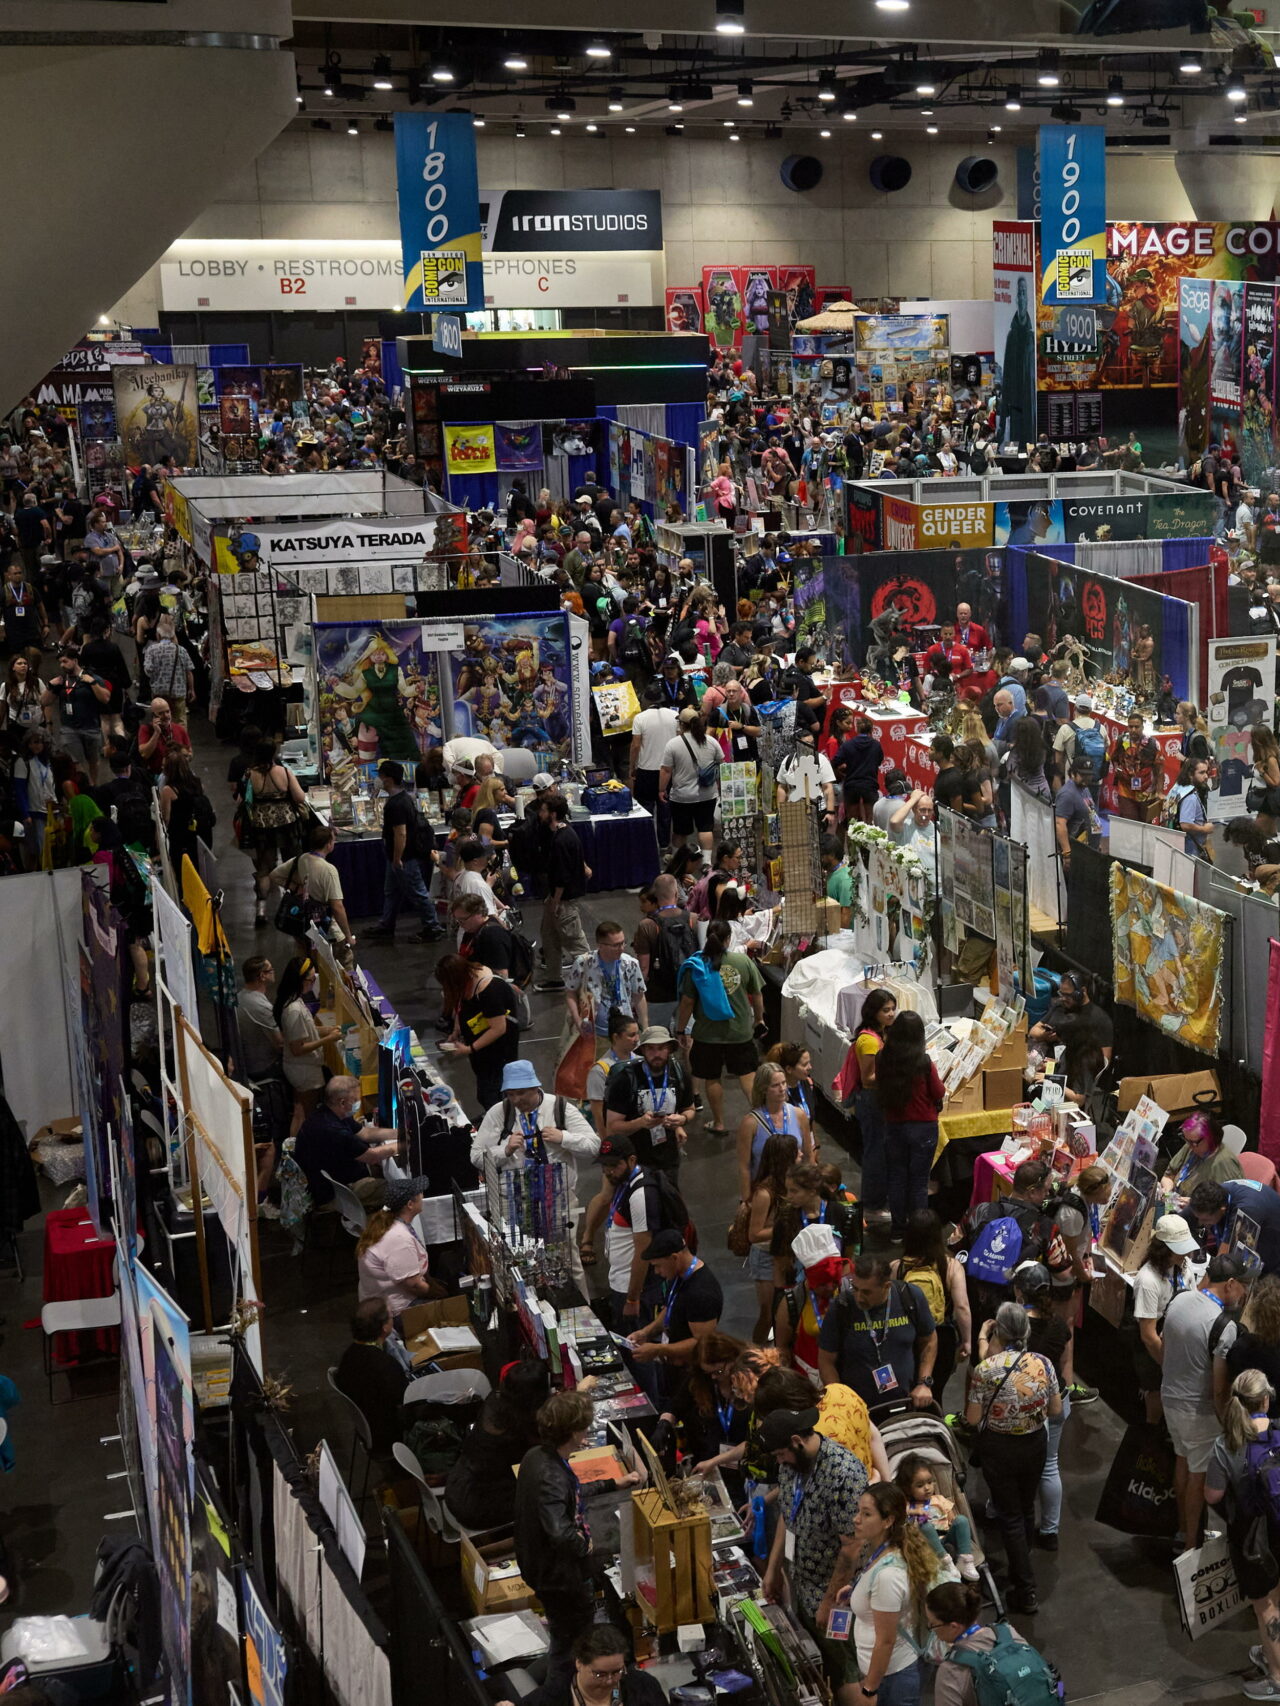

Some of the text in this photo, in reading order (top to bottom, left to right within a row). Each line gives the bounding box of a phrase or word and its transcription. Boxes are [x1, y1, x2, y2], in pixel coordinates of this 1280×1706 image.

[423, 121, 449, 242] 1800
[1061, 133, 1081, 243] 1900
[993, 231, 1033, 266] CRIMINAL
[1112, 228, 1213, 256] MAGE
[179, 260, 404, 277] LOBBY RESTROOMS
[438, 258, 464, 272] CON
[483, 259, 577, 274] EPHONES
[1069, 256, 1091, 268] CON
[424, 258, 439, 298] COMIC
[538, 276, 549, 292] C
[1058, 256, 1070, 292] COMIC
[280, 278, 306, 294] B2
[1181, 284, 1210, 313] Saga
[440, 322, 459, 350] 1800
[1066, 313, 1092, 339] 1900
[130, 368, 188, 392] Mechanika
[922, 507, 986, 522] GENDER
[1069, 502, 1143, 516] COVENANT
[1173, 508, 1186, 516] The
[886, 516, 916, 549] UNIVERSE
[922, 520, 986, 535] QUEER
[1153, 519, 1207, 530] Tea Dragon
[270, 531, 426, 552] KATSUYA TERADA
